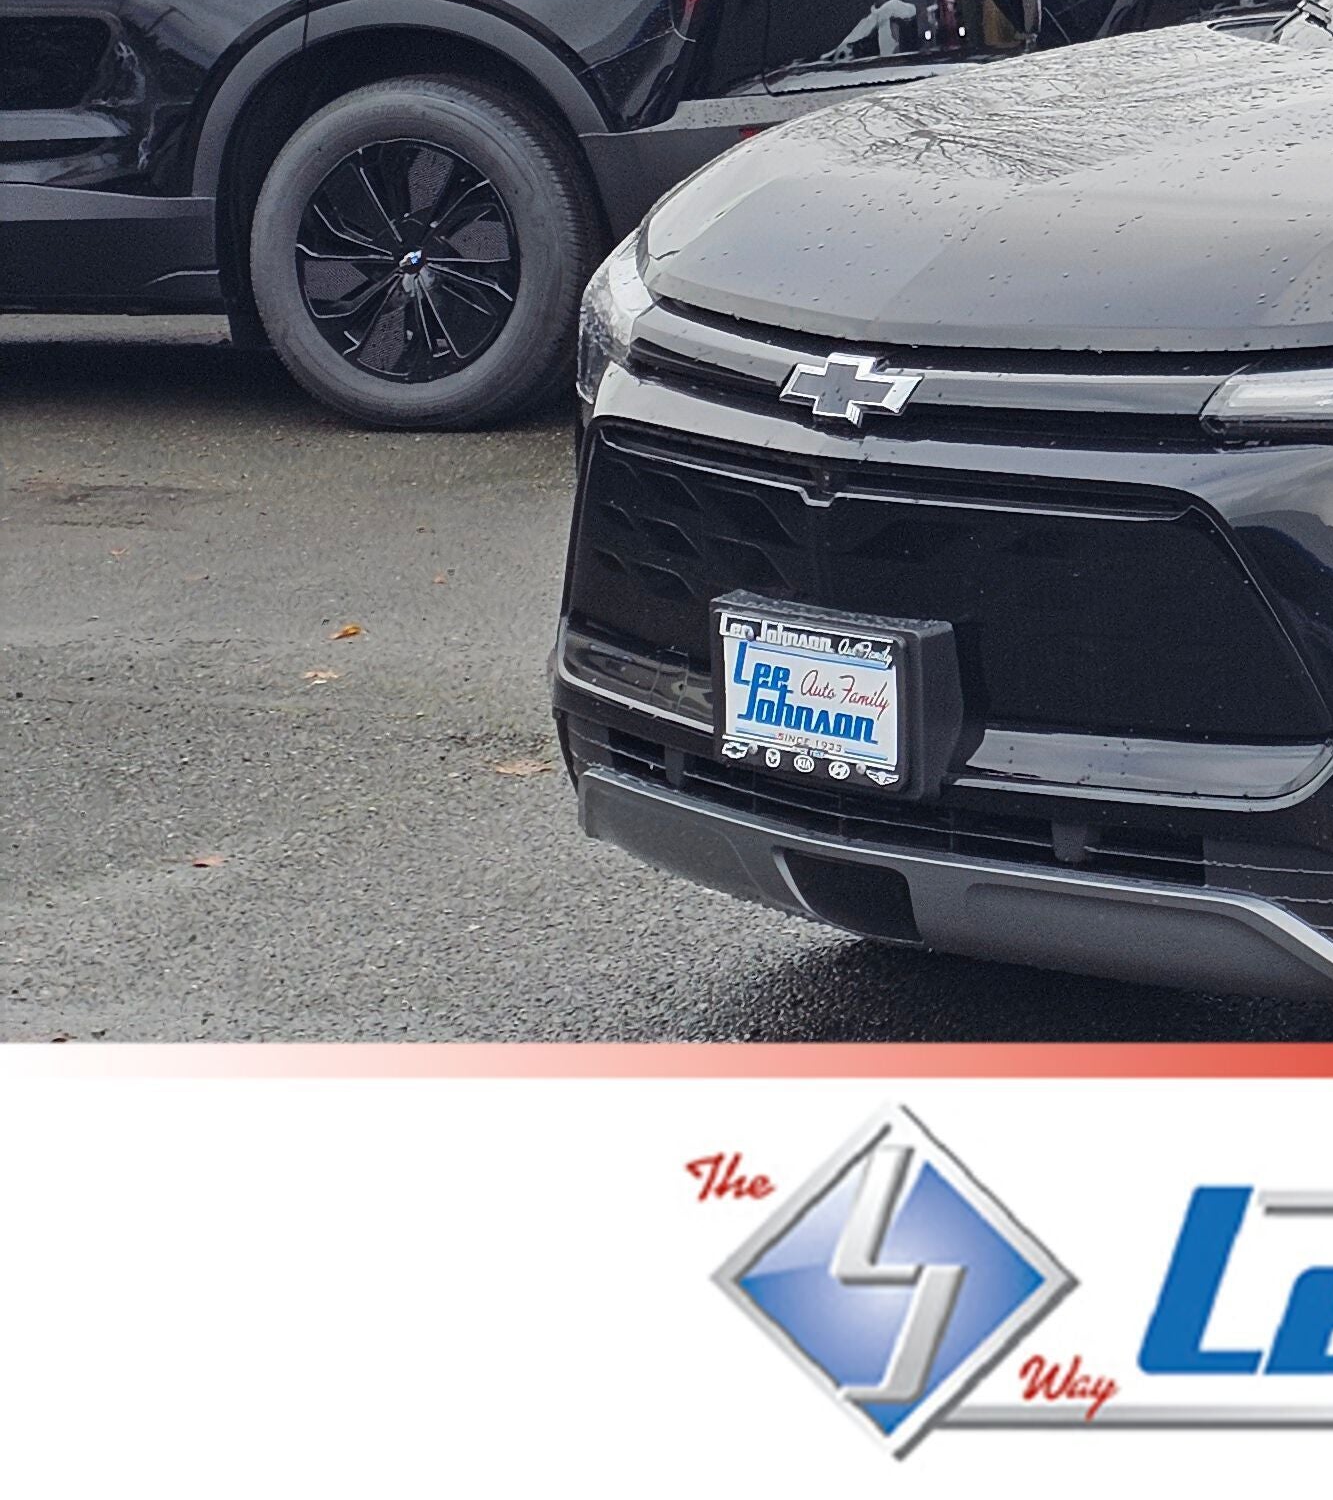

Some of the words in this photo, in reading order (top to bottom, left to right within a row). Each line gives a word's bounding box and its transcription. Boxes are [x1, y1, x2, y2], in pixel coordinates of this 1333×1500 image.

[756, 618, 836, 653] Johnson
[733, 641, 794, 694] Lee
[736, 684, 879, 745] Johnson
[800, 669, 836, 701] Auto
[838, 674, 890, 721] Family
[776, 731, 811, 747] SINCE
